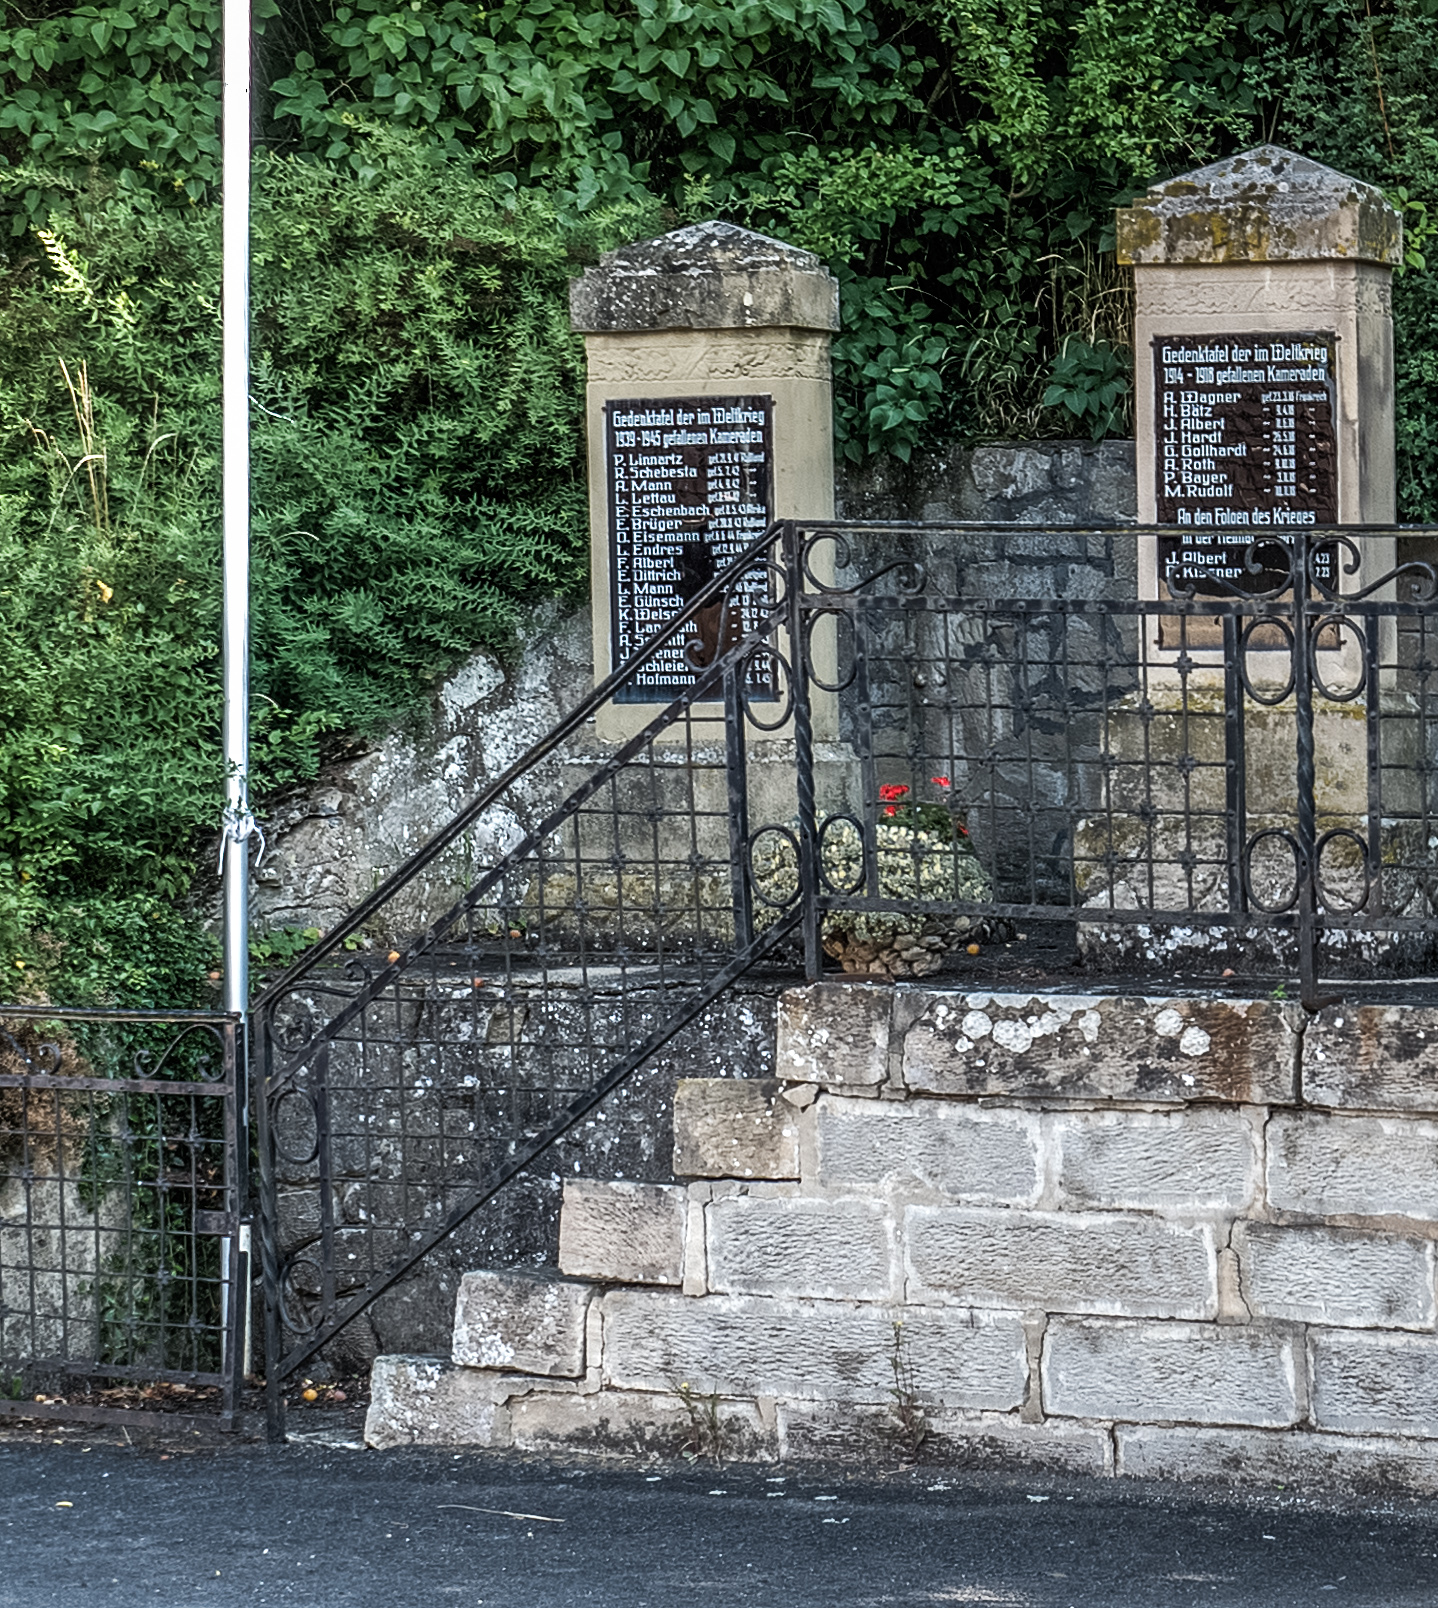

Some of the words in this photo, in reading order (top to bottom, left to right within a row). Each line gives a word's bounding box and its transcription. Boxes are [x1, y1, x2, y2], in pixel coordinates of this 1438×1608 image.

[1162, 345, 1228, 364] Gedenktafel
[1232, 345, 1251, 362] der
[1254, 344, 1268, 362] im
[1270, 343, 1327, 363] Weltkrieg
[1163, 367, 1184, 384] 1914
[1216, 365, 1265, 386] gefallenen
[1267, 364, 1325, 383] Kameraden
[1164, 392, 1177, 404] A.
[1180, 391, 1241, 405] Wagner
[613, 410, 674, 427] Gedenktafel
[677, 409, 694, 425] der
[697, 409, 711, 424] im
[712, 407, 764, 426] Weltkrieg
[1163, 404, 1177, 417] H.
[1180, 404, 1213, 417] Bätz
[1164, 418, 1178, 431] J.
[1181, 417, 1225, 430] Albert
[710, 428, 763, 444] Kameraden
[1164, 432, 1178, 444] J.
[1181, 431, 1222, 443] Hardt
[1165, 445, 1178, 457] G.
[1181, 443, 1247, 457] Gollhardt
[629, 454, 683, 465] Linnartz
[1164, 459, 1179, 471] A.
[1182, 458, 1215, 470] Roth
[630, 466, 697, 478] Schebesta
[1163, 472, 1178, 484] P.
[1181, 471, 1227, 485] Bayer
[631, 480, 671, 491] Mann
[1164, 485, 1185, 497] M.
[1187, 484, 1233, 497] Rudolf
[632, 493, 676, 504] Lettau
[632, 505, 709, 517] Eschenbach
[1194, 507, 1212, 525] den
[1252, 507, 1270, 524] des
[632, 518, 682, 531] Brüger
[633, 531, 700, 542] Eisemann
[633, 544, 683, 555] Endres
[633, 557, 674, 568] Albert
[1165, 552, 1179, 565] J.
[633, 570, 681, 581] Dittrich
[633, 583, 673, 594] Mann
[634, 594, 684, 608] Günsch
[636, 673, 696, 685] Hofmann
